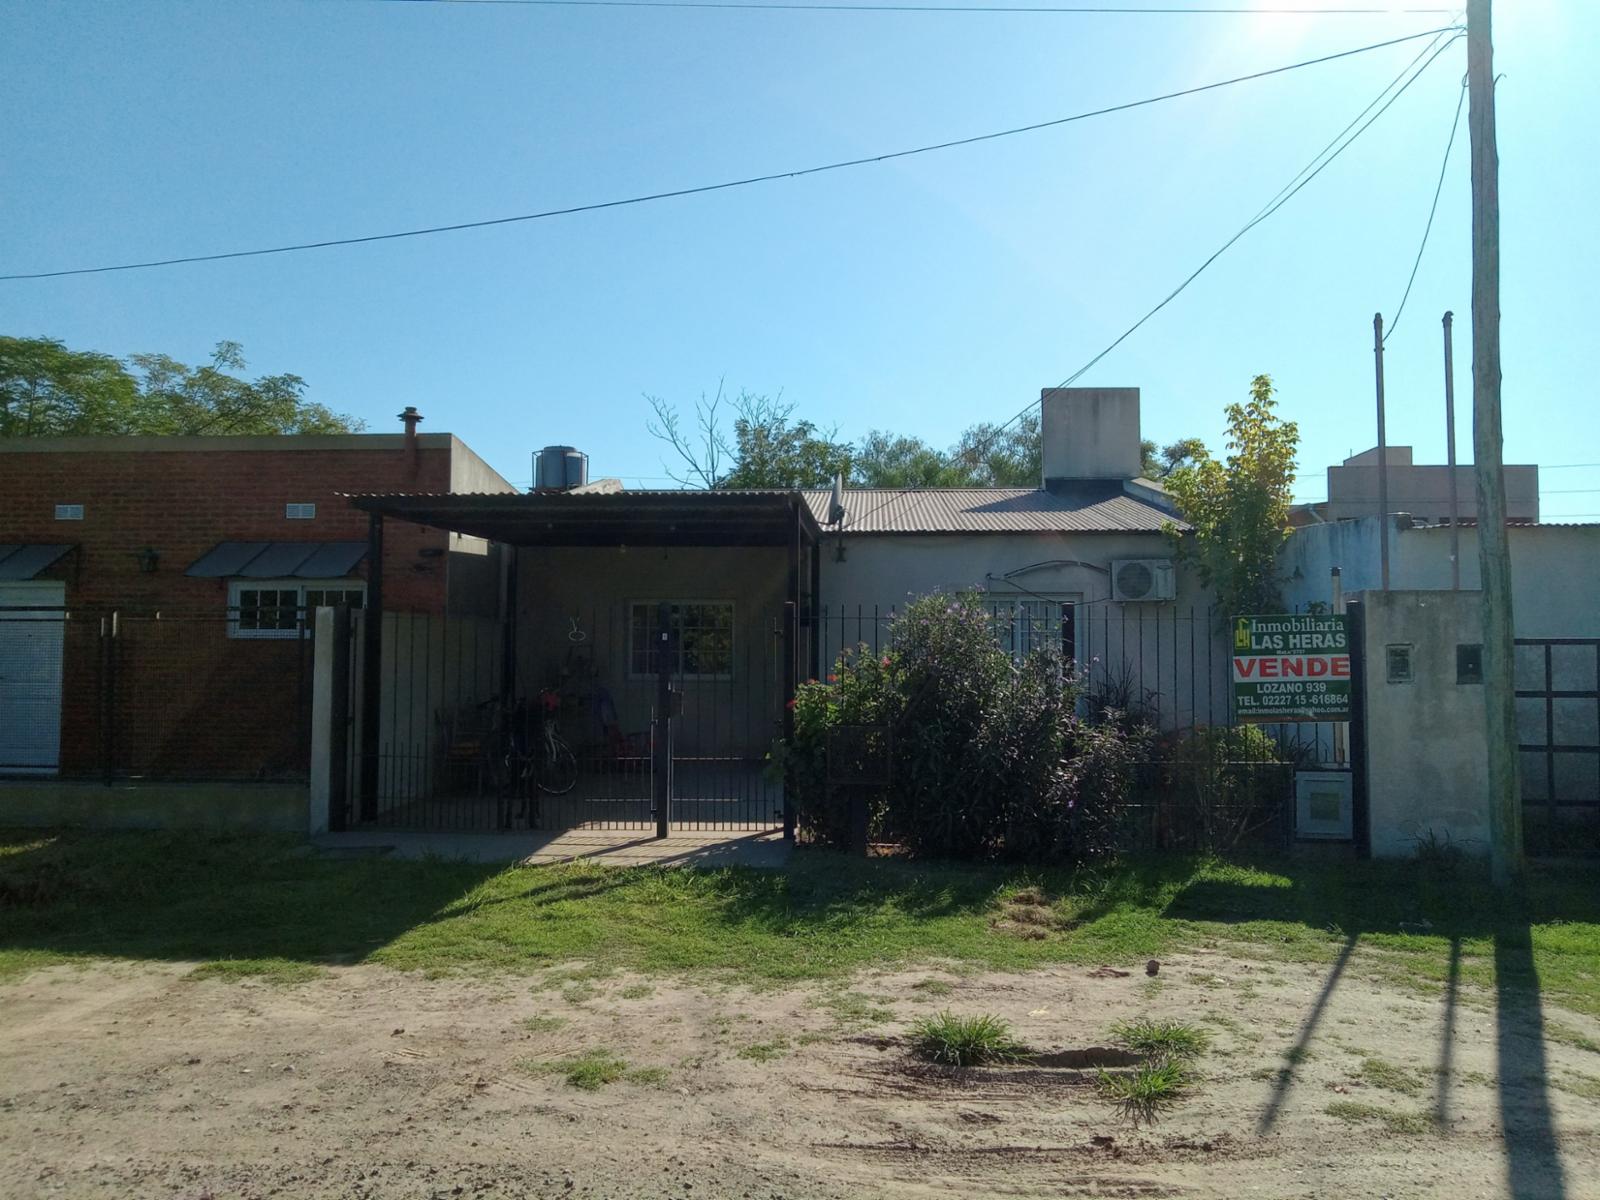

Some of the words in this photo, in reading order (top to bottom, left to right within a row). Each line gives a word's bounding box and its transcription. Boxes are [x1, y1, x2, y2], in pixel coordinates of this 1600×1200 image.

[1251, 618, 1344, 633] Inmobiliaria
[1251, 634, 1283, 649] LAS
[1288, 633, 1346, 648] HERAS
[1234, 657, 1351, 678] VENDE
[1256, 683, 1303, 694] LOZANO
[1306, 682, 1327, 692] 939
[1237, 695, 1260, 706] TEL.
[1262, 695, 1292, 706] 02227
[1294, 695, 1307, 705] 15
